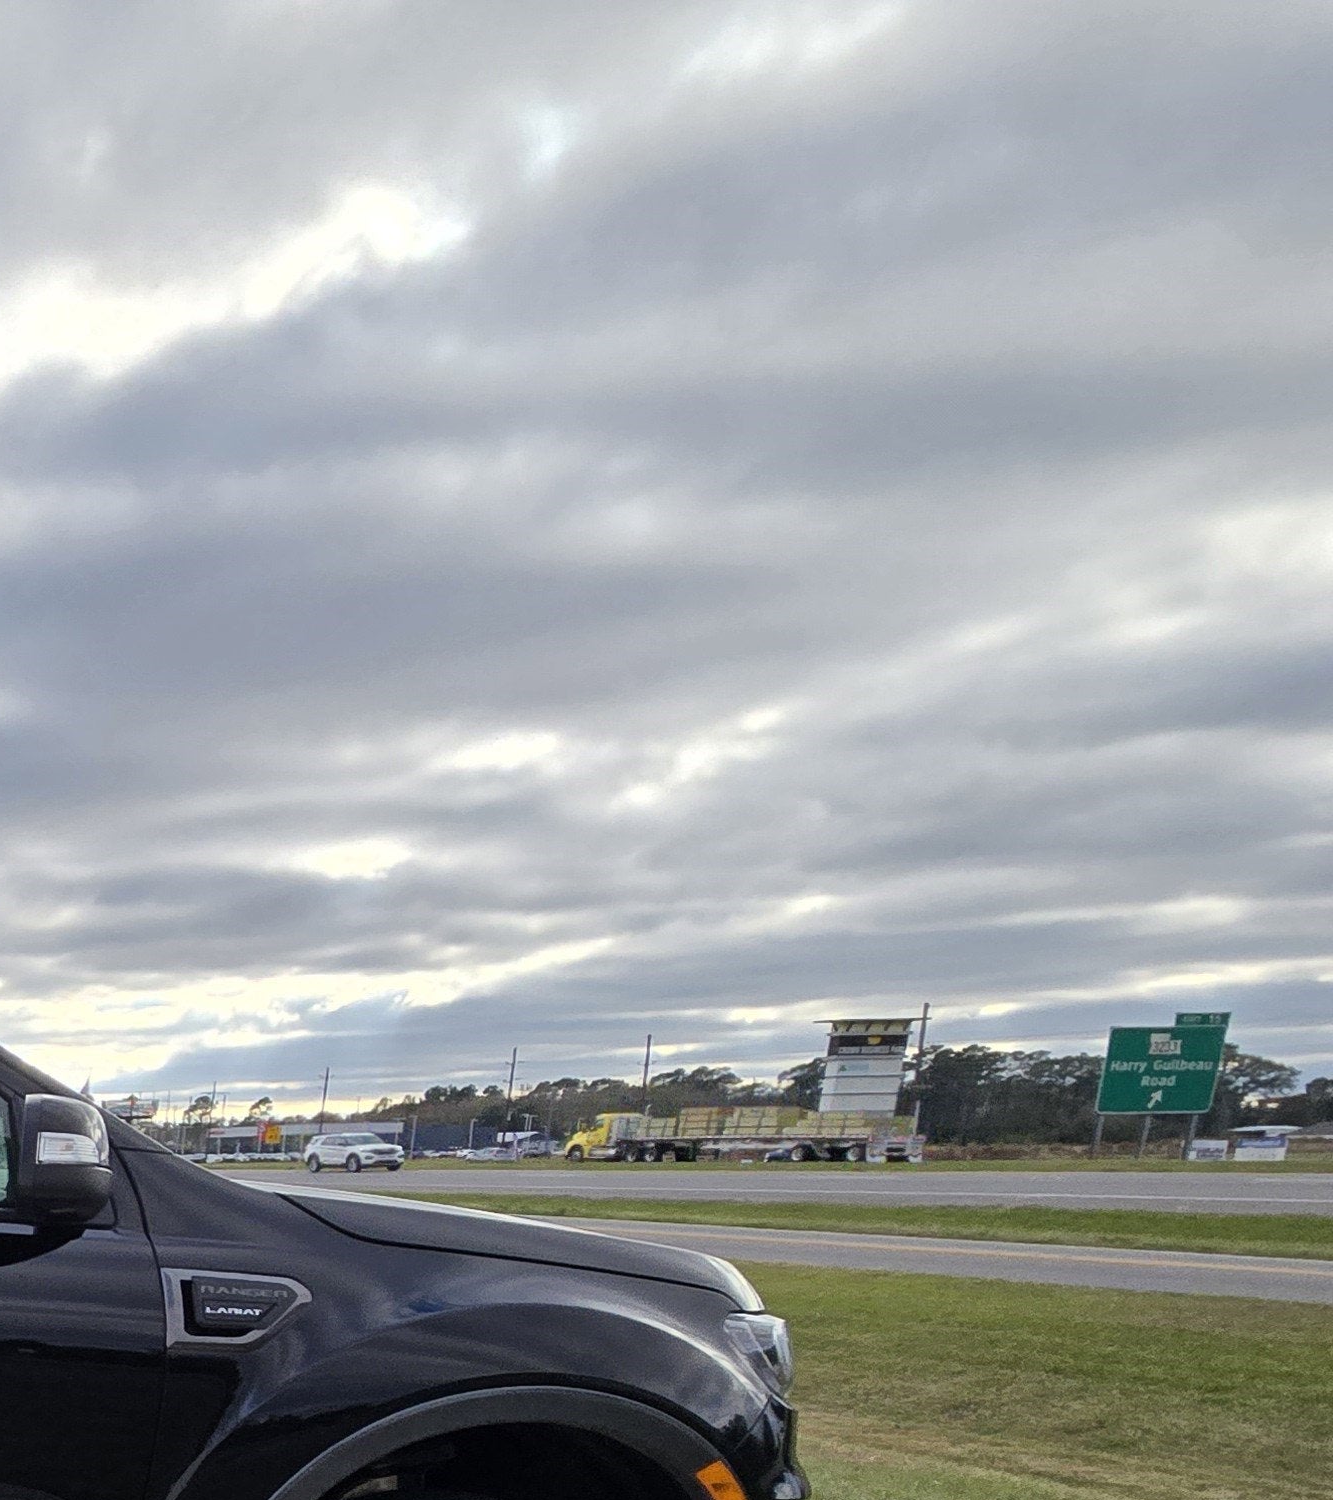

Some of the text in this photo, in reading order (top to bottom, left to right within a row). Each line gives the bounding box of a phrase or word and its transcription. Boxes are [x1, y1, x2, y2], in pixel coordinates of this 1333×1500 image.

[1110, 1059, 1214, 1073] Harry Guilbeau
[1141, 1075, 1177, 1087] Road
[199, 1284, 289, 1299] RANGER
[204, 1306, 263, 1316] LARIAT
